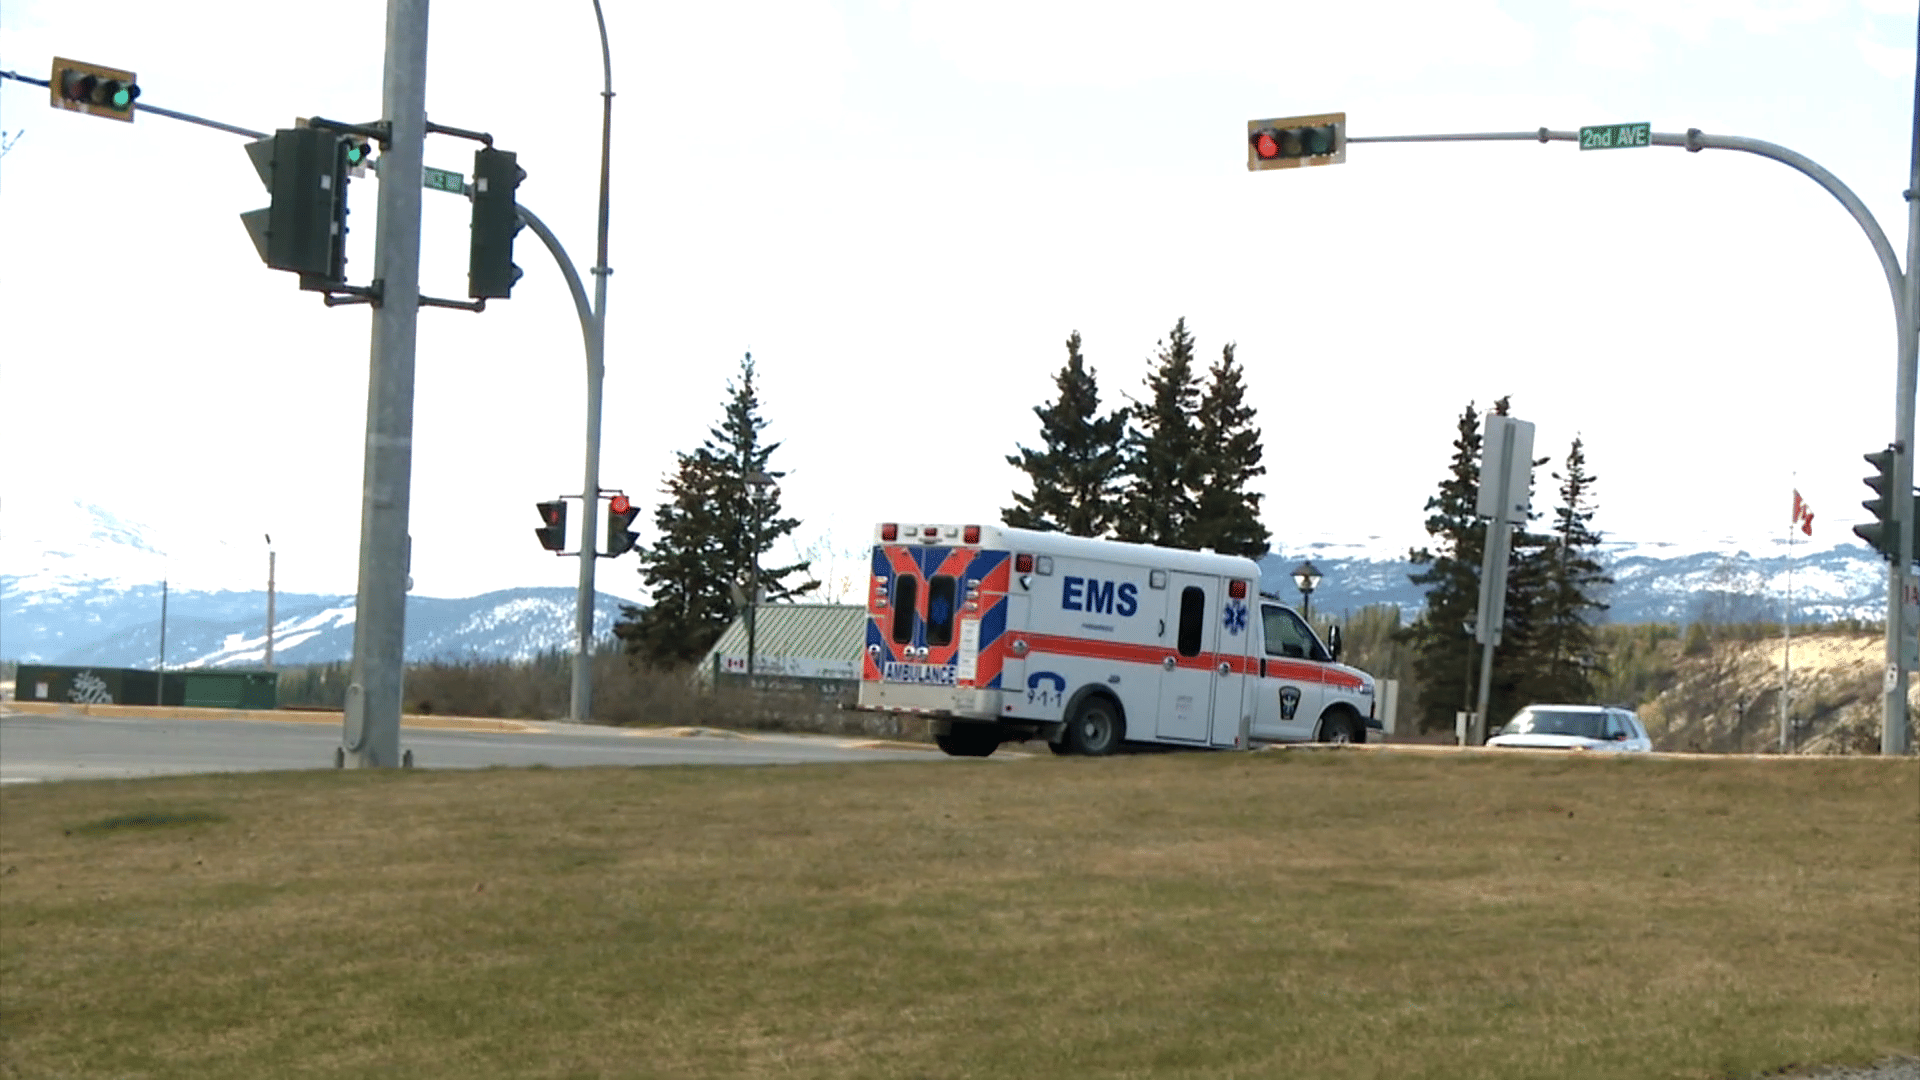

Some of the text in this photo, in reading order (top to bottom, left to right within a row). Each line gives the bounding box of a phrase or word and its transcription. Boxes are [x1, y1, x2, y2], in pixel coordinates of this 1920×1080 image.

[1583, 126, 1646, 147] 2nd AVE
[1062, 575, 1138, 617] EMS
[885, 663, 956, 684] AMBULANCE
